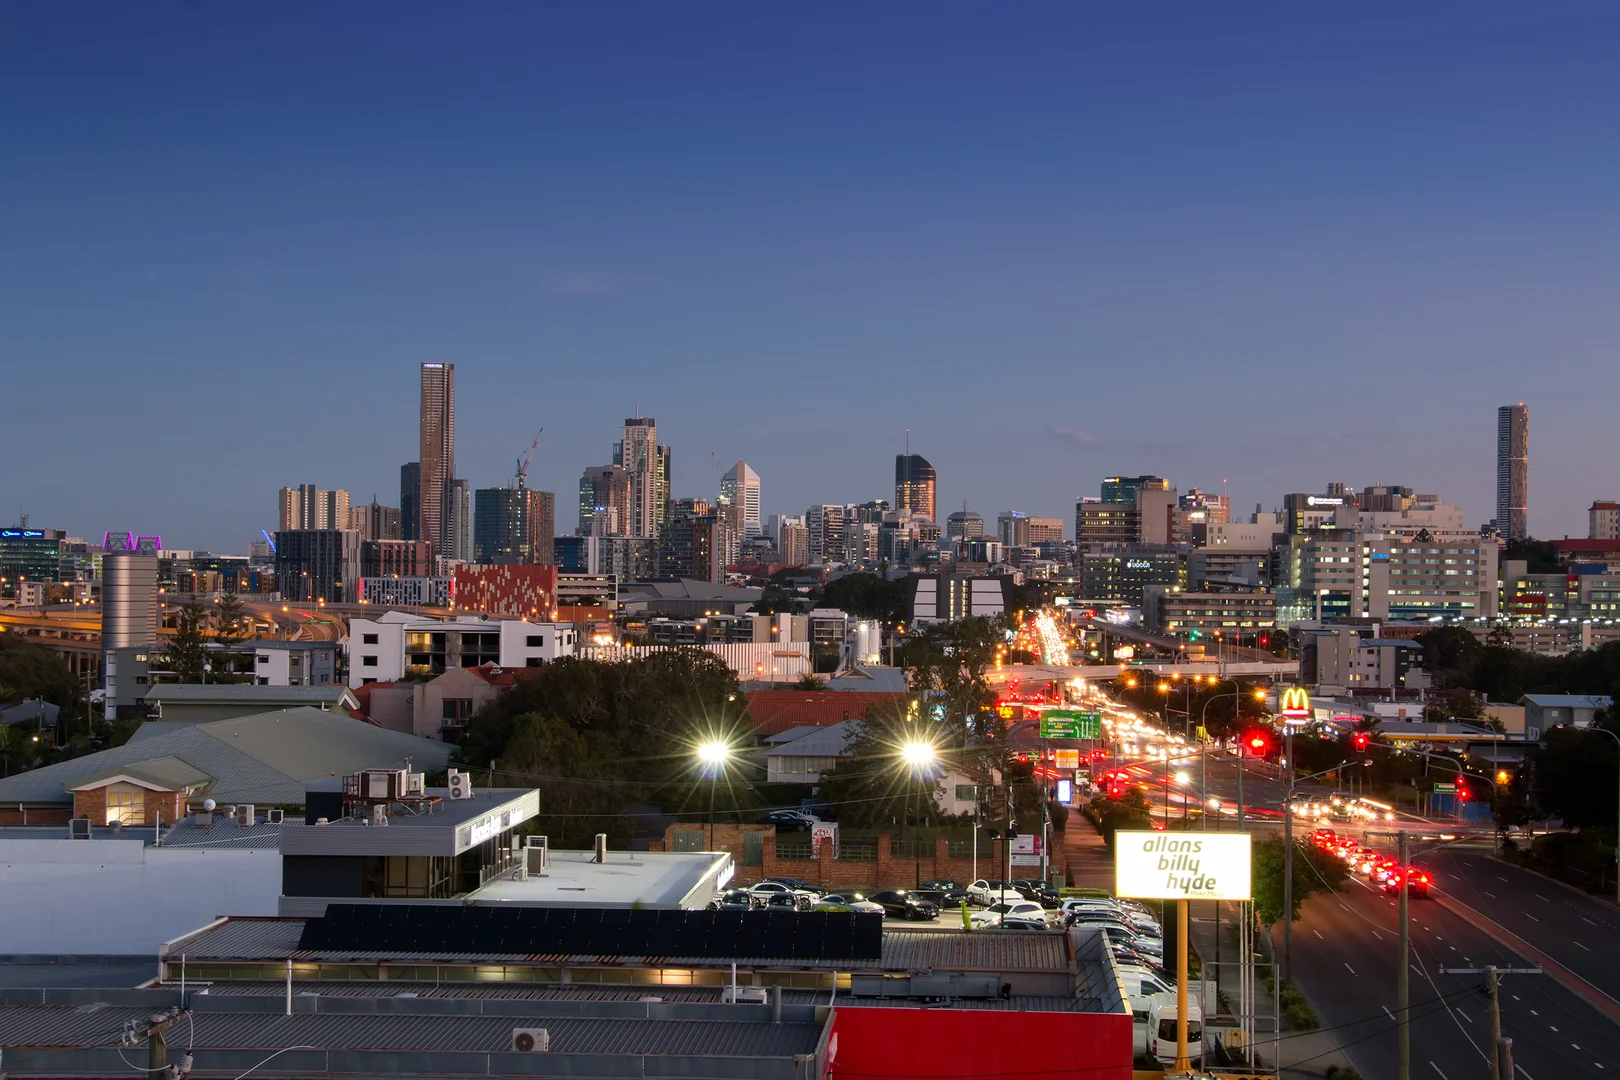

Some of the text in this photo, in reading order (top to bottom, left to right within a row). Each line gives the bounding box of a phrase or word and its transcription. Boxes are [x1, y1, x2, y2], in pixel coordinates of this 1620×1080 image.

[1143, 836, 1203, 853] allans
[1158, 854, 1200, 875] billy
[1166, 873, 1216, 894] hyde
